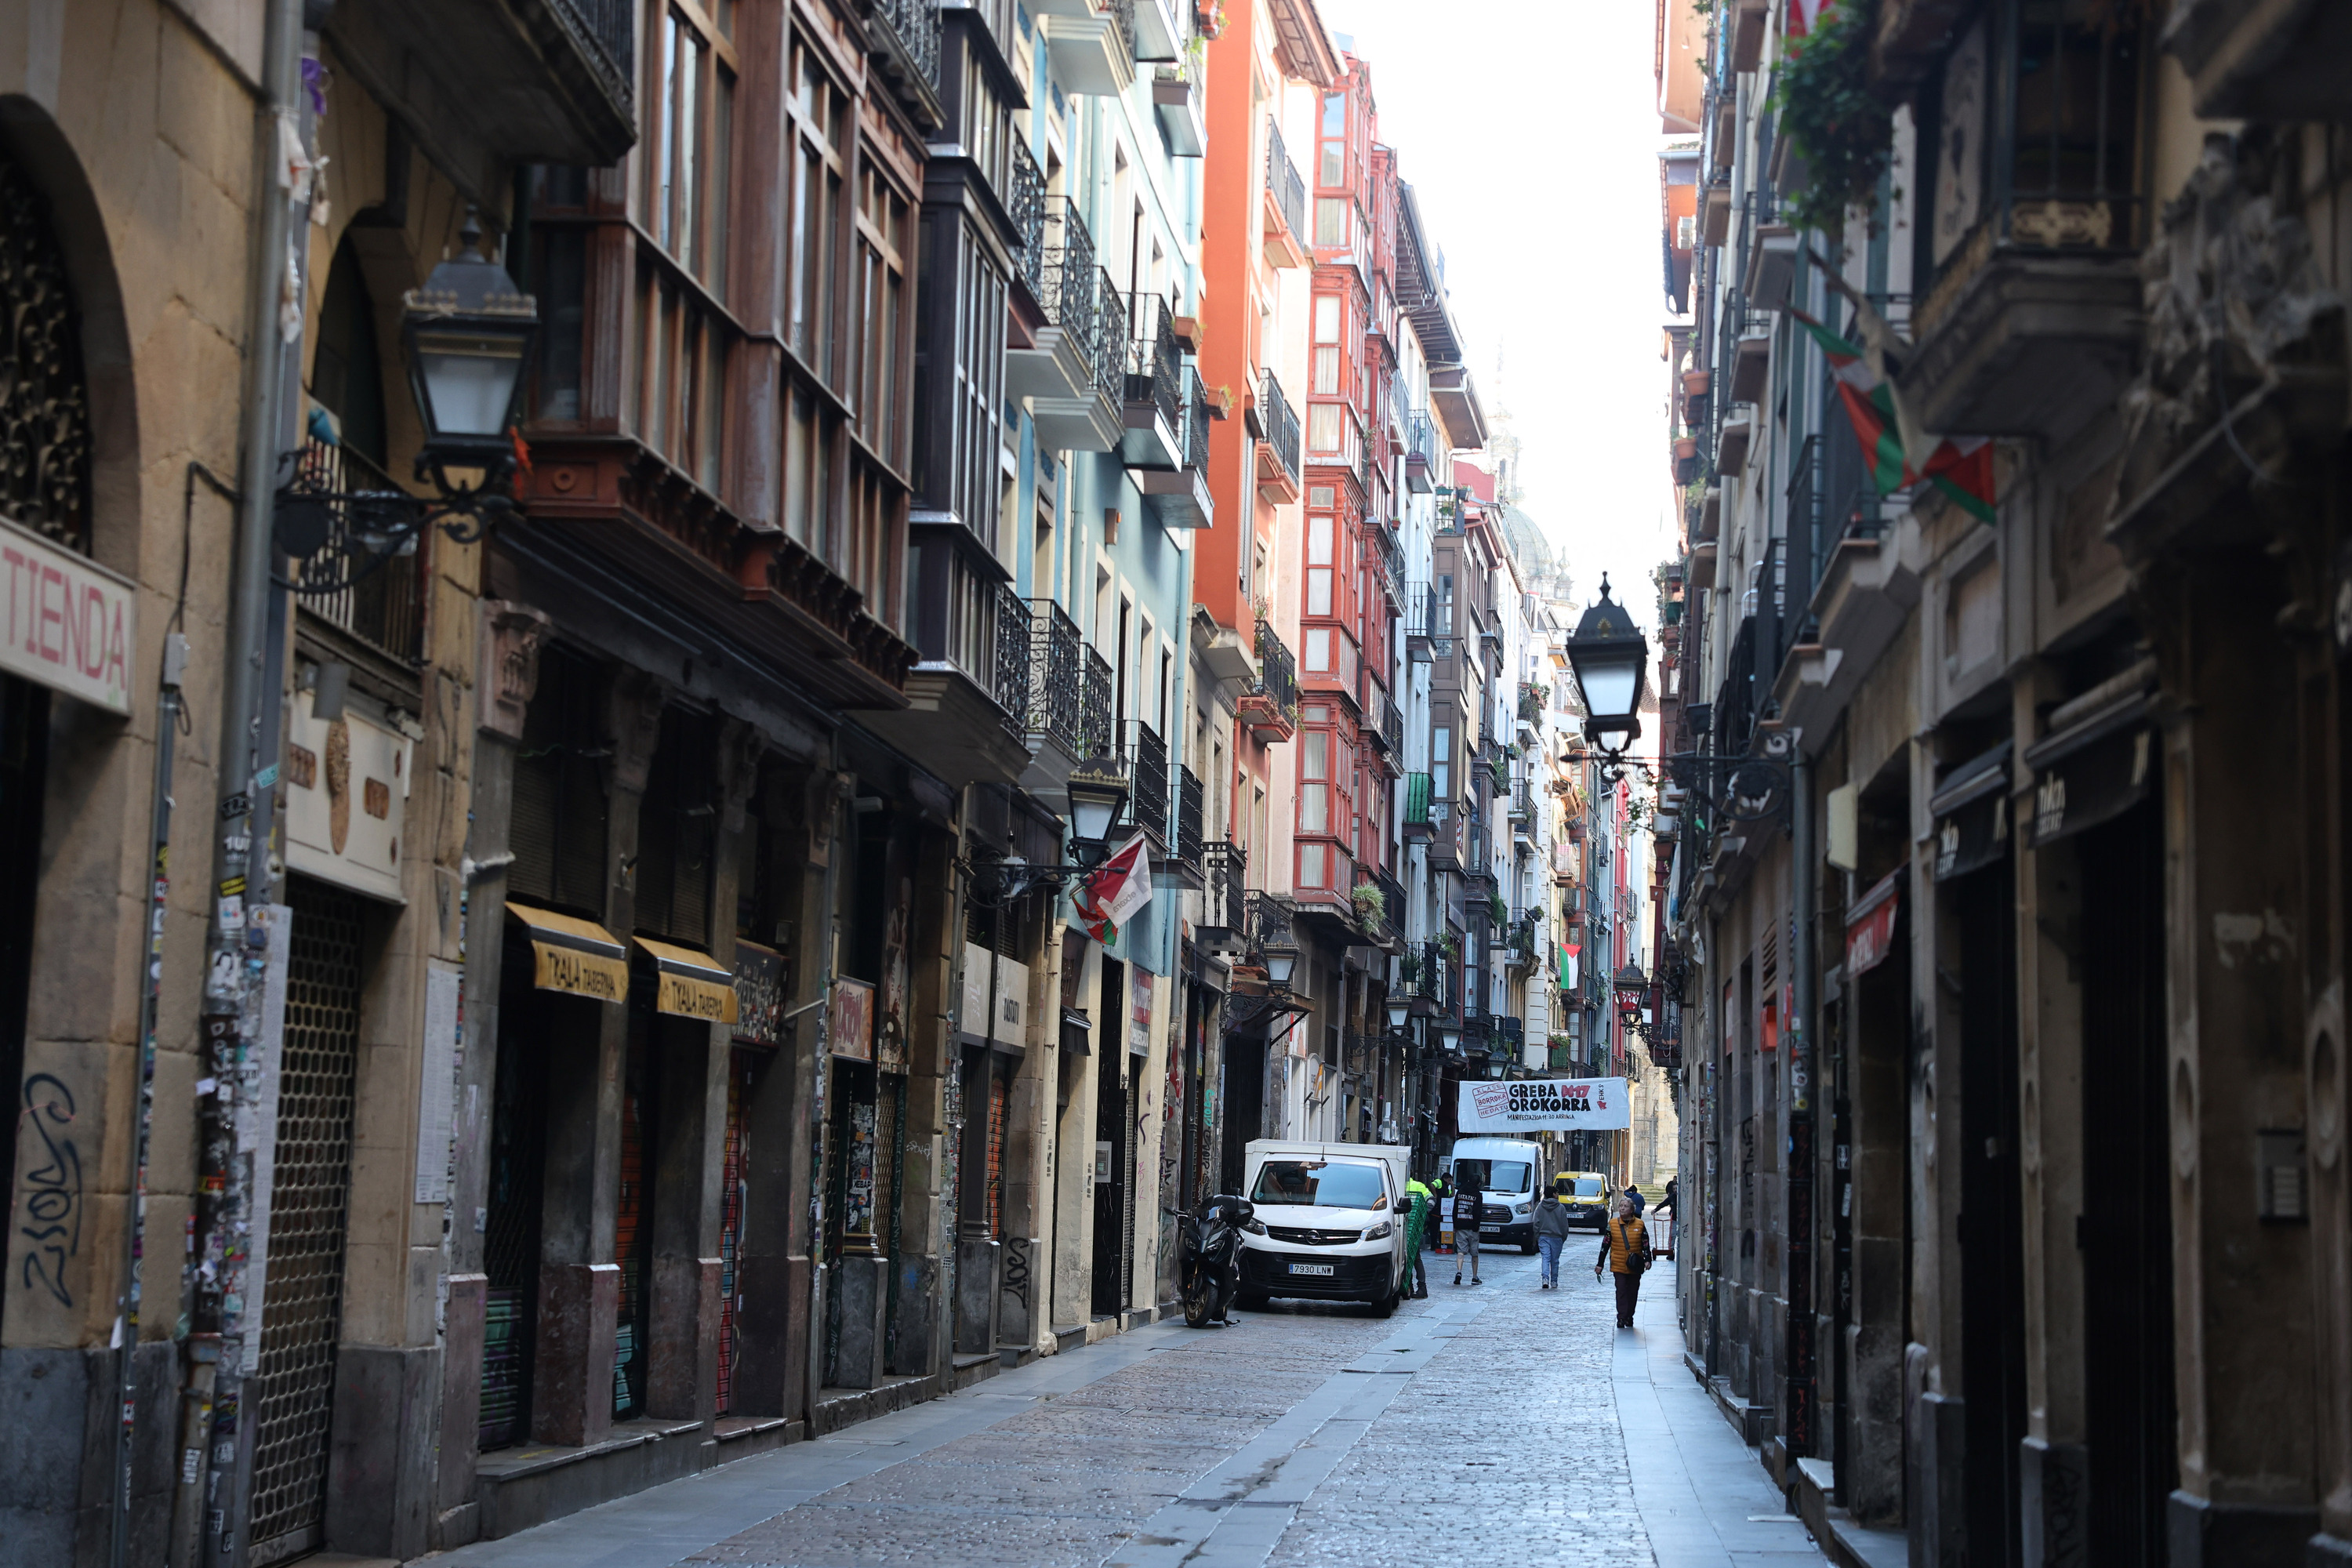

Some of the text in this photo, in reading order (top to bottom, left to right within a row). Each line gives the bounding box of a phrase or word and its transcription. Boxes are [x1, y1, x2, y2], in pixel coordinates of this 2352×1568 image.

[2, 546, 125, 691] TIENDA
[1476, 1083, 1501, 1094] KLASE
[1509, 1083, 1558, 1098] GREBA
[1478, 1094, 1506, 1105] BORROKA
[1508, 1098, 1591, 1112] OROKORRA
[1480, 1105, 1508, 1116] HEDATU
